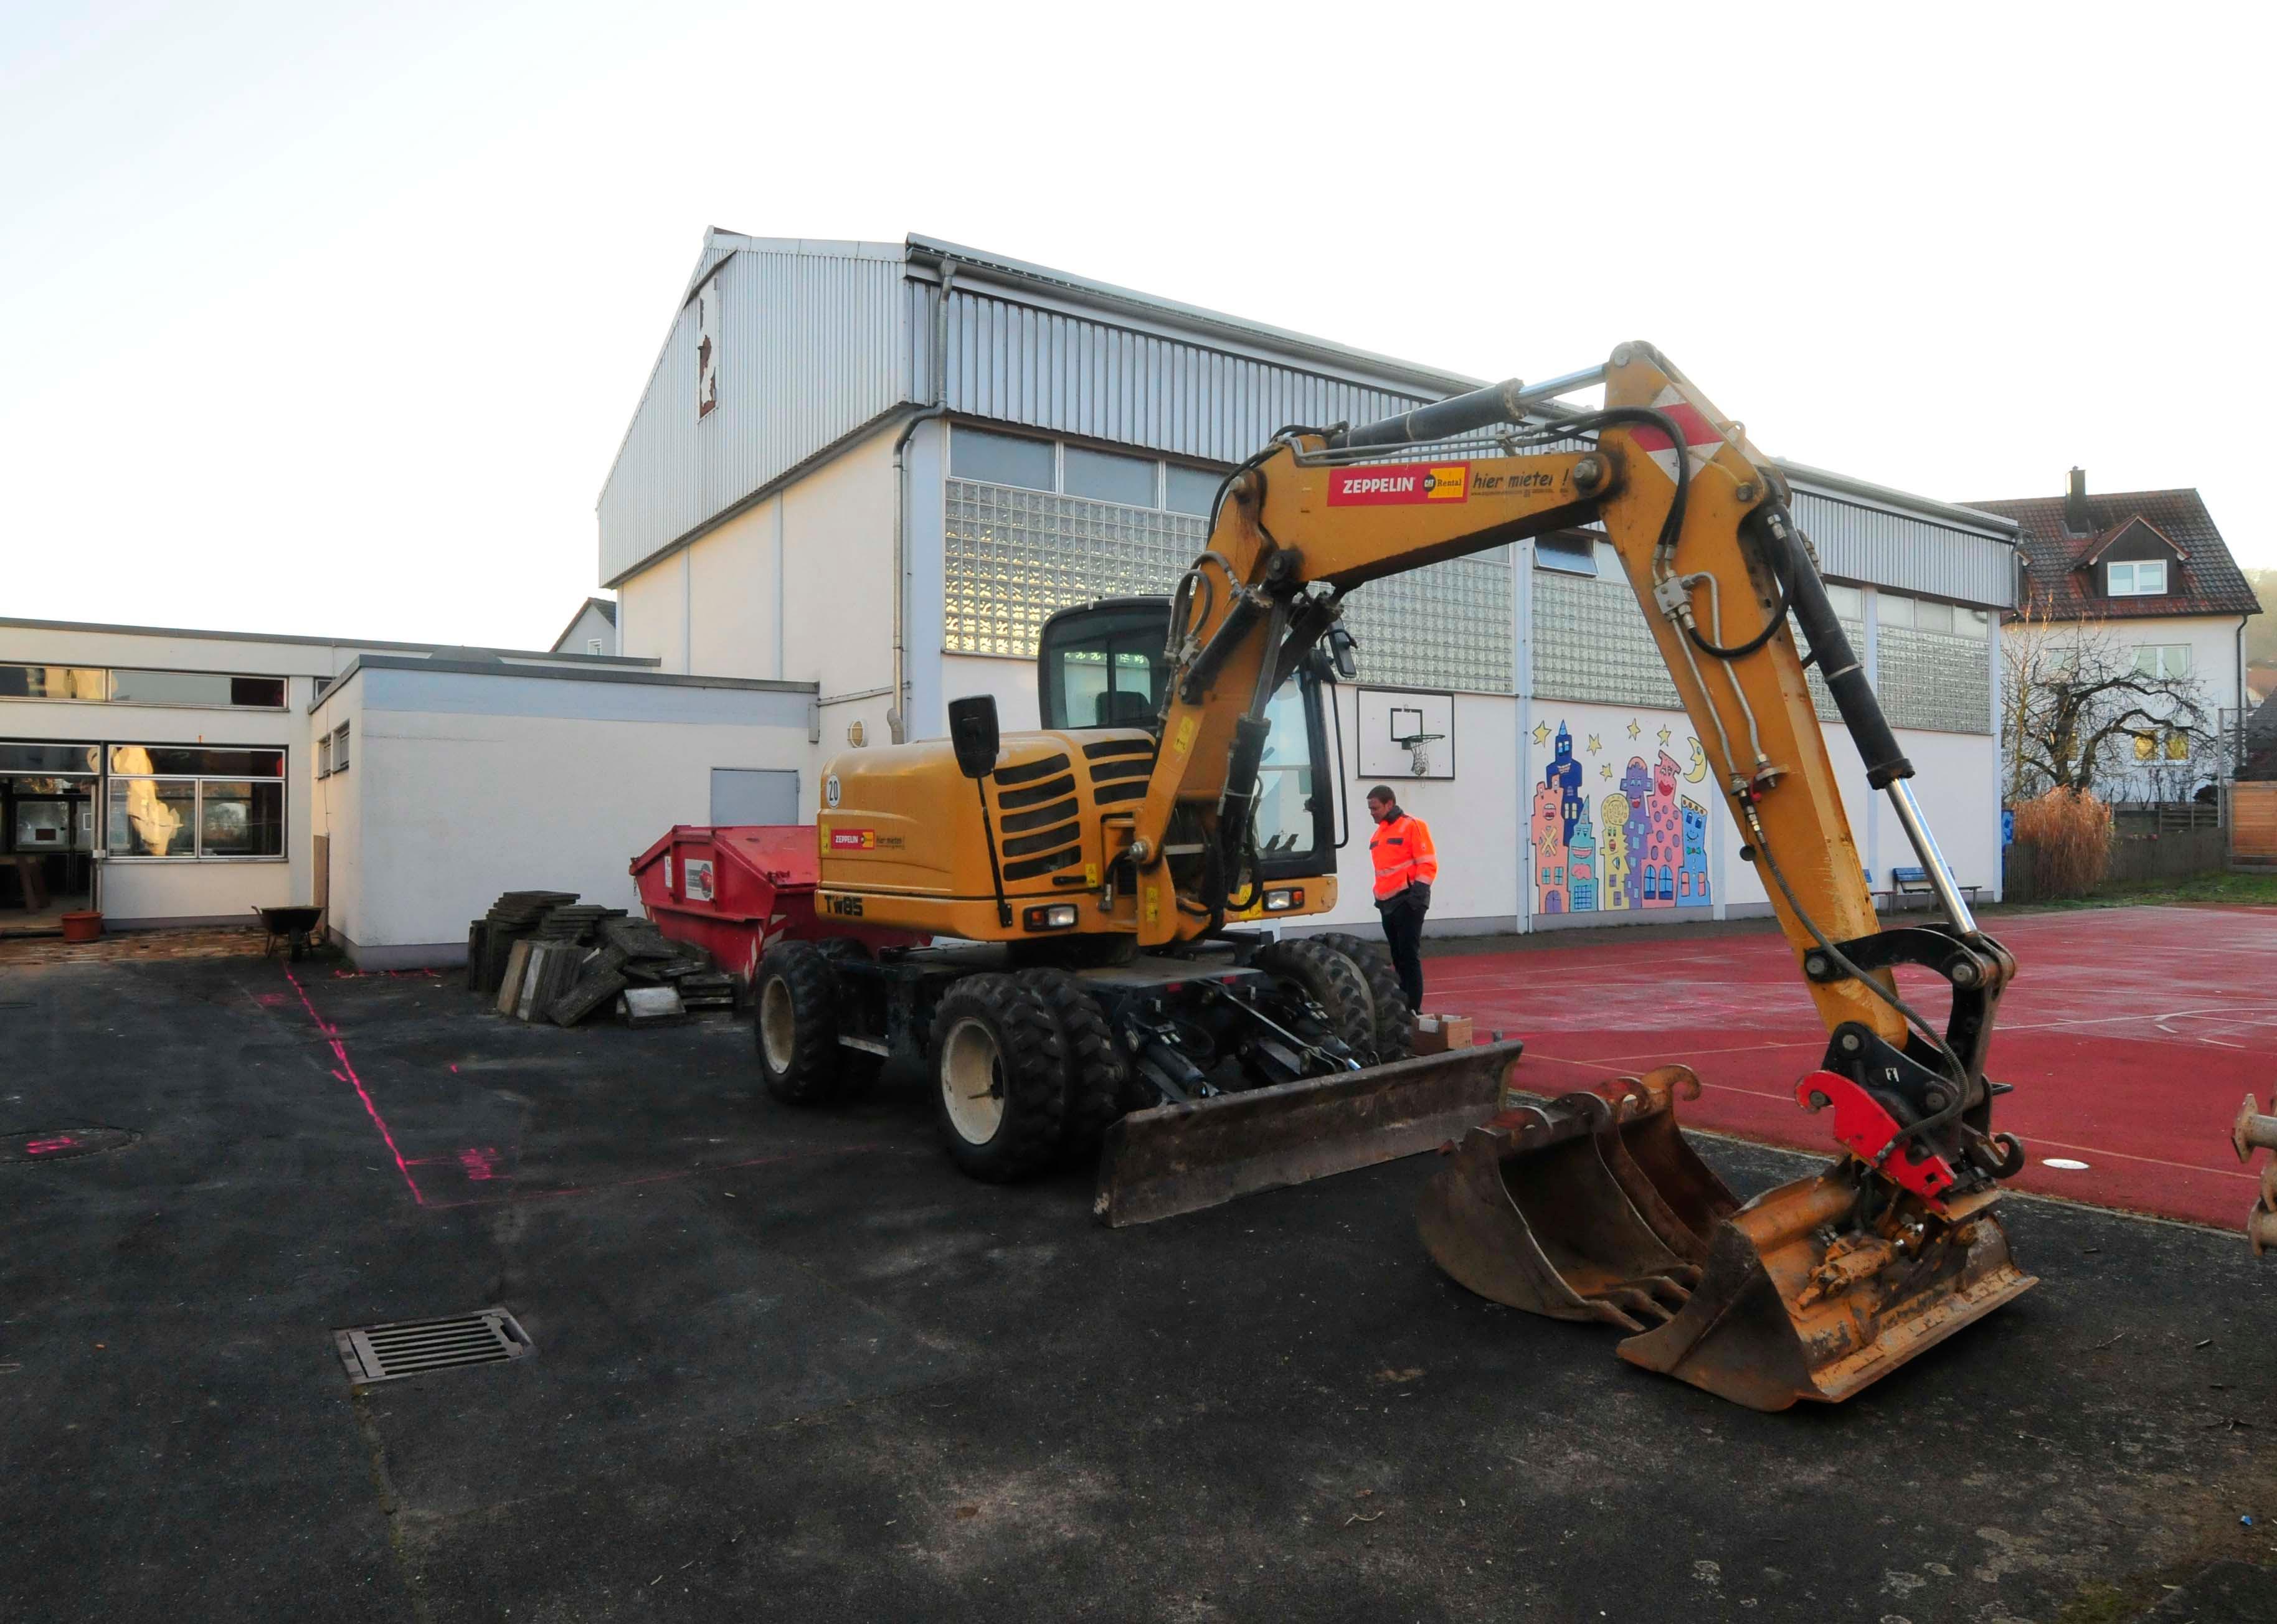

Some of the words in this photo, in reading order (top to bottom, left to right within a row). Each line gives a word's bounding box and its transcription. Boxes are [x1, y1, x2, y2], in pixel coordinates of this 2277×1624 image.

[1343, 477, 1414, 493] ZEPPELIN
[1437, 479, 1462, 487] Rental
[1472, 471, 1504, 489] hier
[829, 780, 838, 801] 20
[835, 835, 858, 844] ZEPPELIN
[824, 895, 863, 917] TW85
